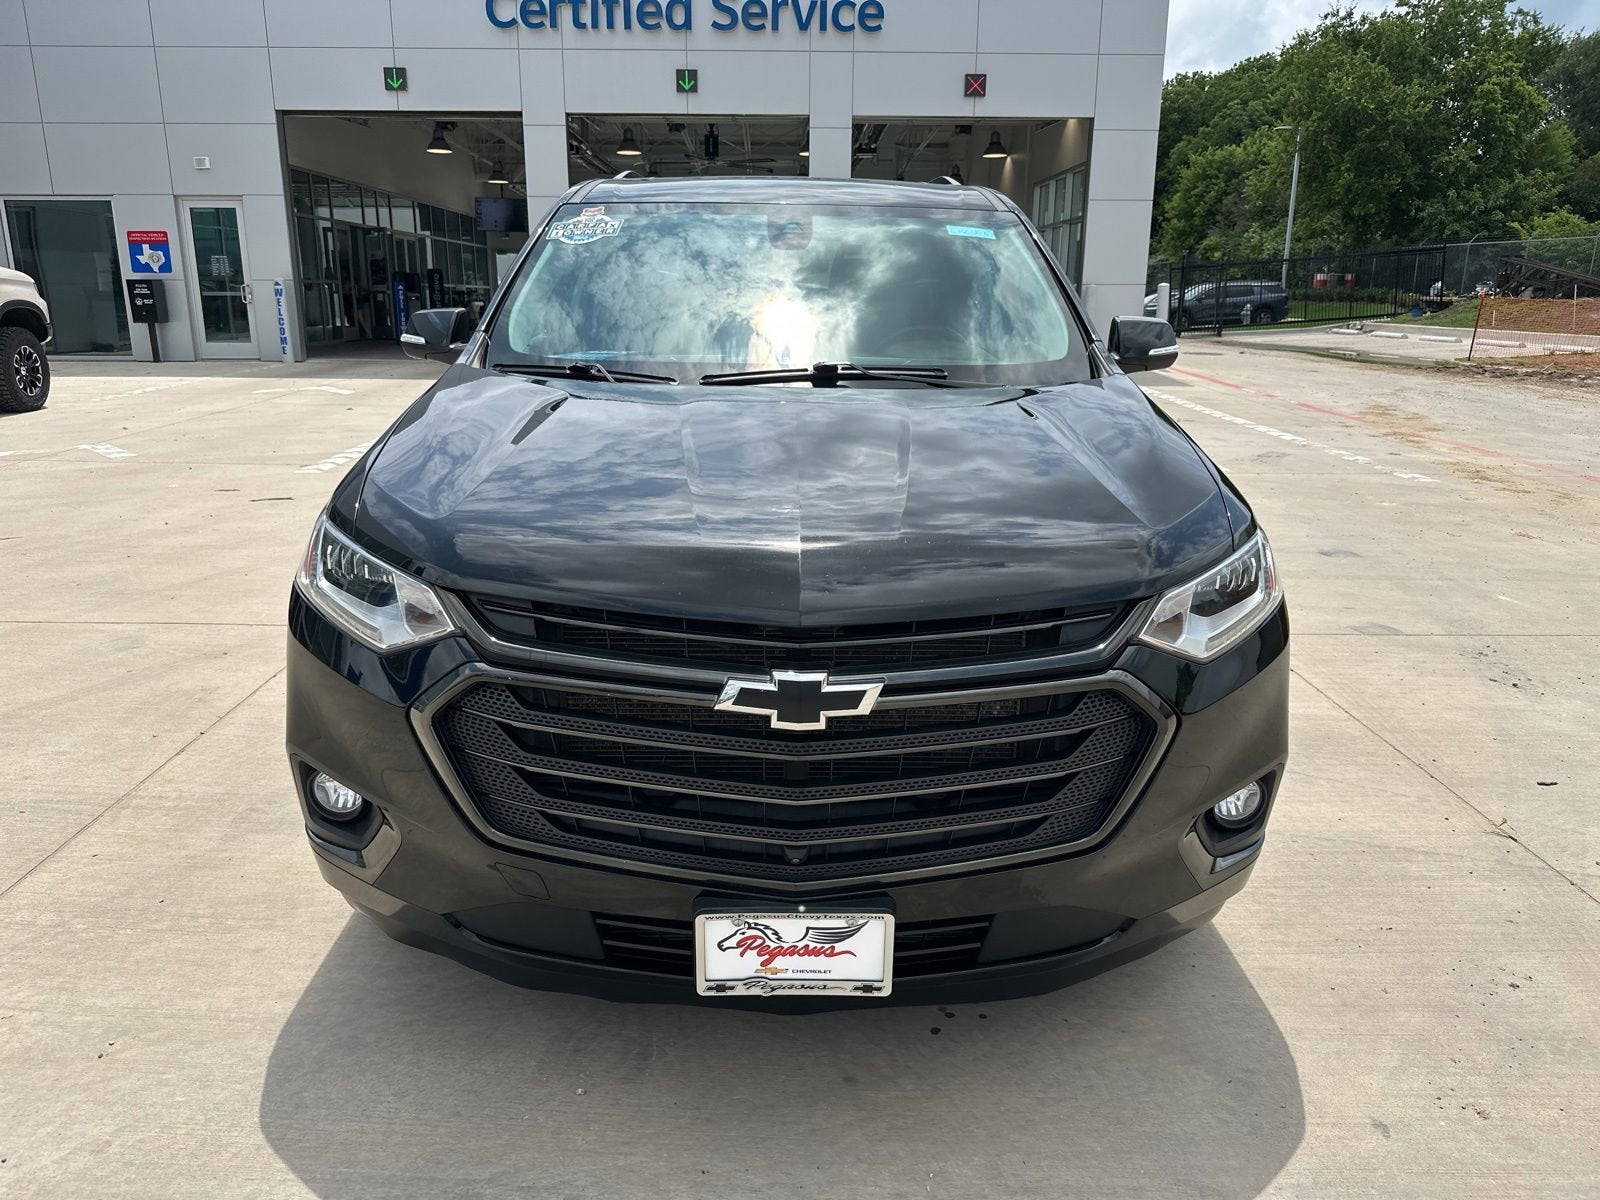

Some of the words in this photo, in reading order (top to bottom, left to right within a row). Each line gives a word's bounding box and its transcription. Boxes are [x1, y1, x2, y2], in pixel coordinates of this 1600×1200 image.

[485, 0, 693, 31] Certified
[711, 0, 885, 32] Service
[556, 222, 617, 230] CARFAX
[274, 288, 288, 354] WELCOME
[736, 934, 857, 967] Pegasus
[743, 980, 847, 994] Pegasus
